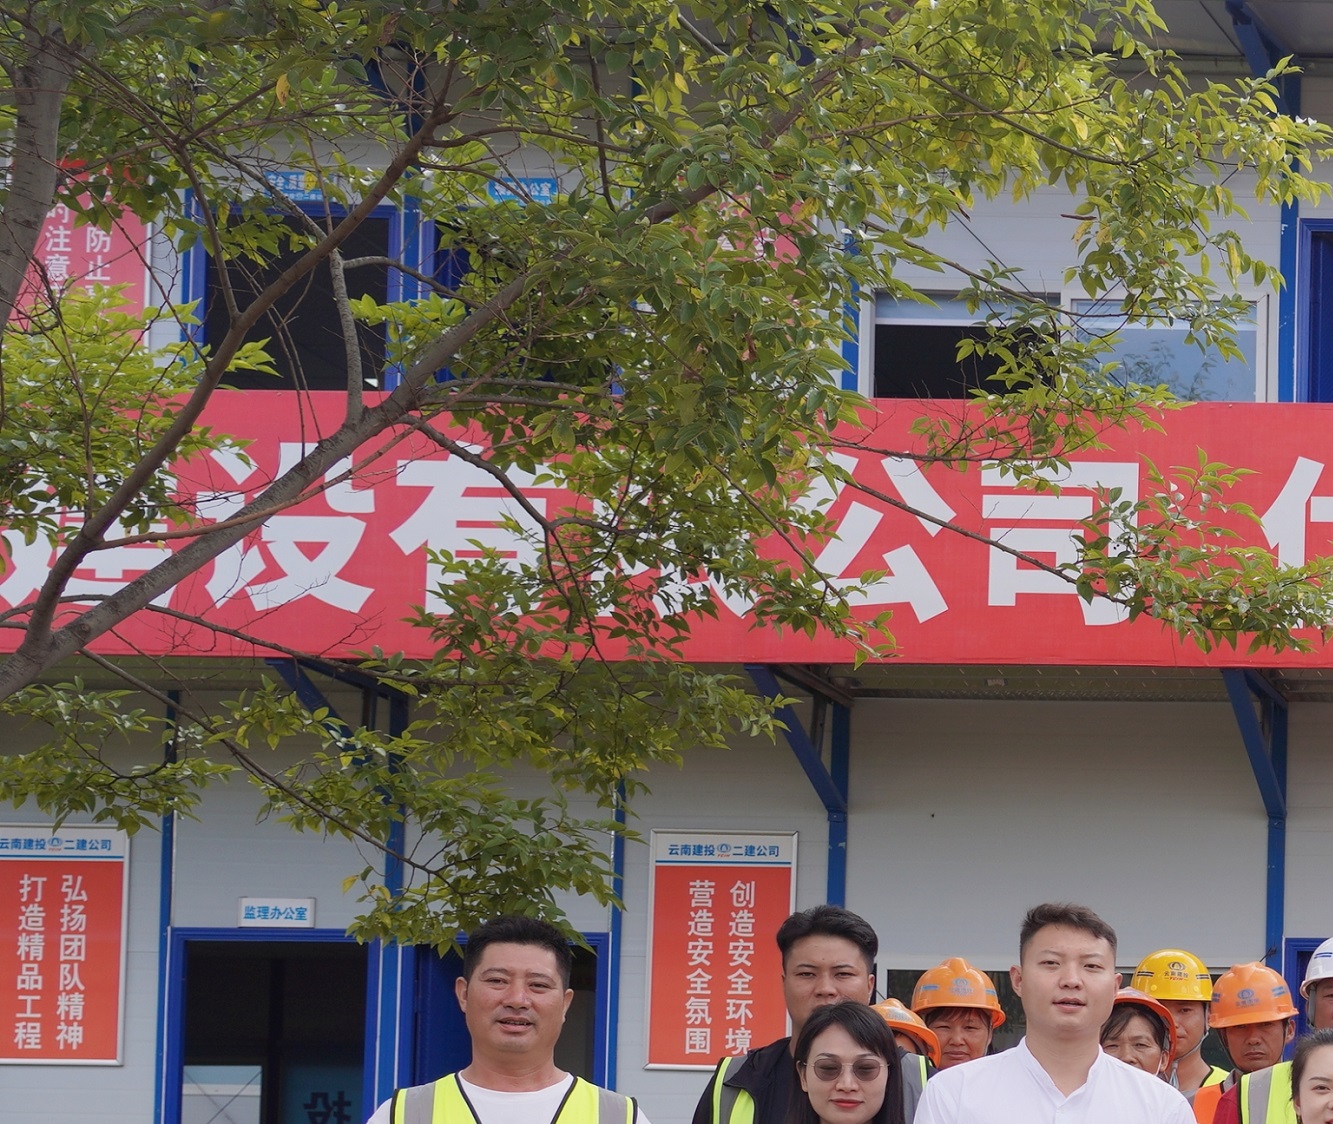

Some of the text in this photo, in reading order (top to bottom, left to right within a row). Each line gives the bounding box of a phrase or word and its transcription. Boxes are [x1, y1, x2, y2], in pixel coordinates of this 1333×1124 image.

[0, 440, 1140, 628] 建设有公司
[0, 837, 112, 851] 云南建投 二建公司
[243, 905, 308, 921] 监理办公室
[668, 844, 715, 857] 云南建投
[733, 845, 779, 858] 二建公司
[14, 874, 47, 1050] 打造精品工程
[56, 874, 88, 1050] 弘扬团队精神
[684, 880, 716, 1055] 营造安全氛围
[725, 880, 756, 1055] 创造安全环境
